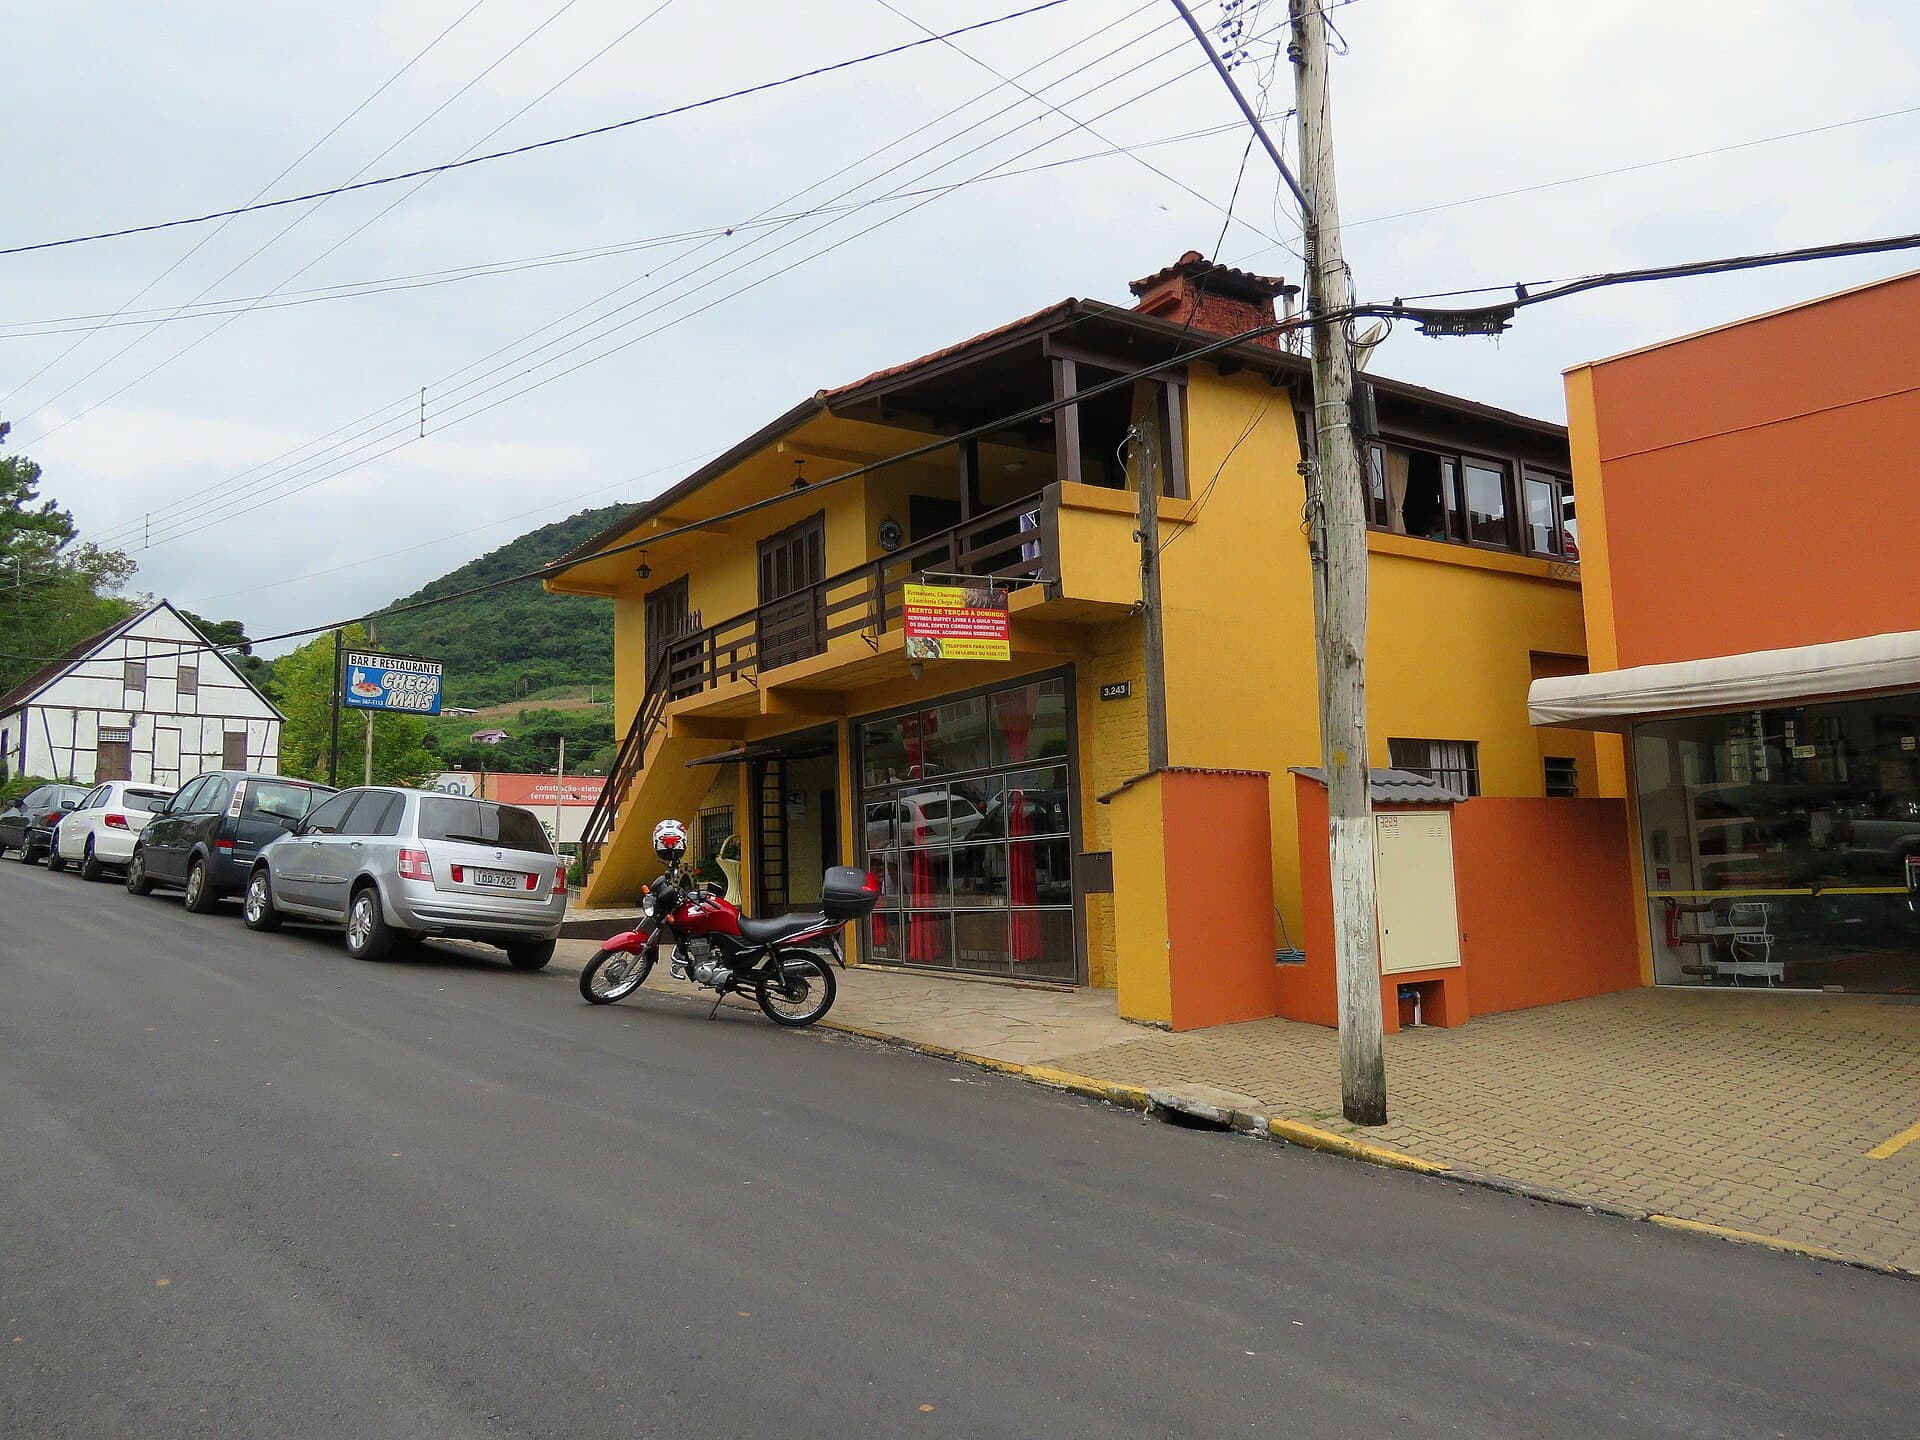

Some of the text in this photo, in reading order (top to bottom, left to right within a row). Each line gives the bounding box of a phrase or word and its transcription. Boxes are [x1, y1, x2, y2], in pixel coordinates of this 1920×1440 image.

[907, 607, 933, 615] ABERTO
[976, 610, 1006, 618] DOMINGO.
[351, 654, 440, 674] BAR E RESTAURANTE
[381, 671, 439, 694] CHEGA
[1104, 685, 1125, 696] 3.243
[385, 691, 434, 711] MAIS
[530, 792, 577, 800] ferramnta
